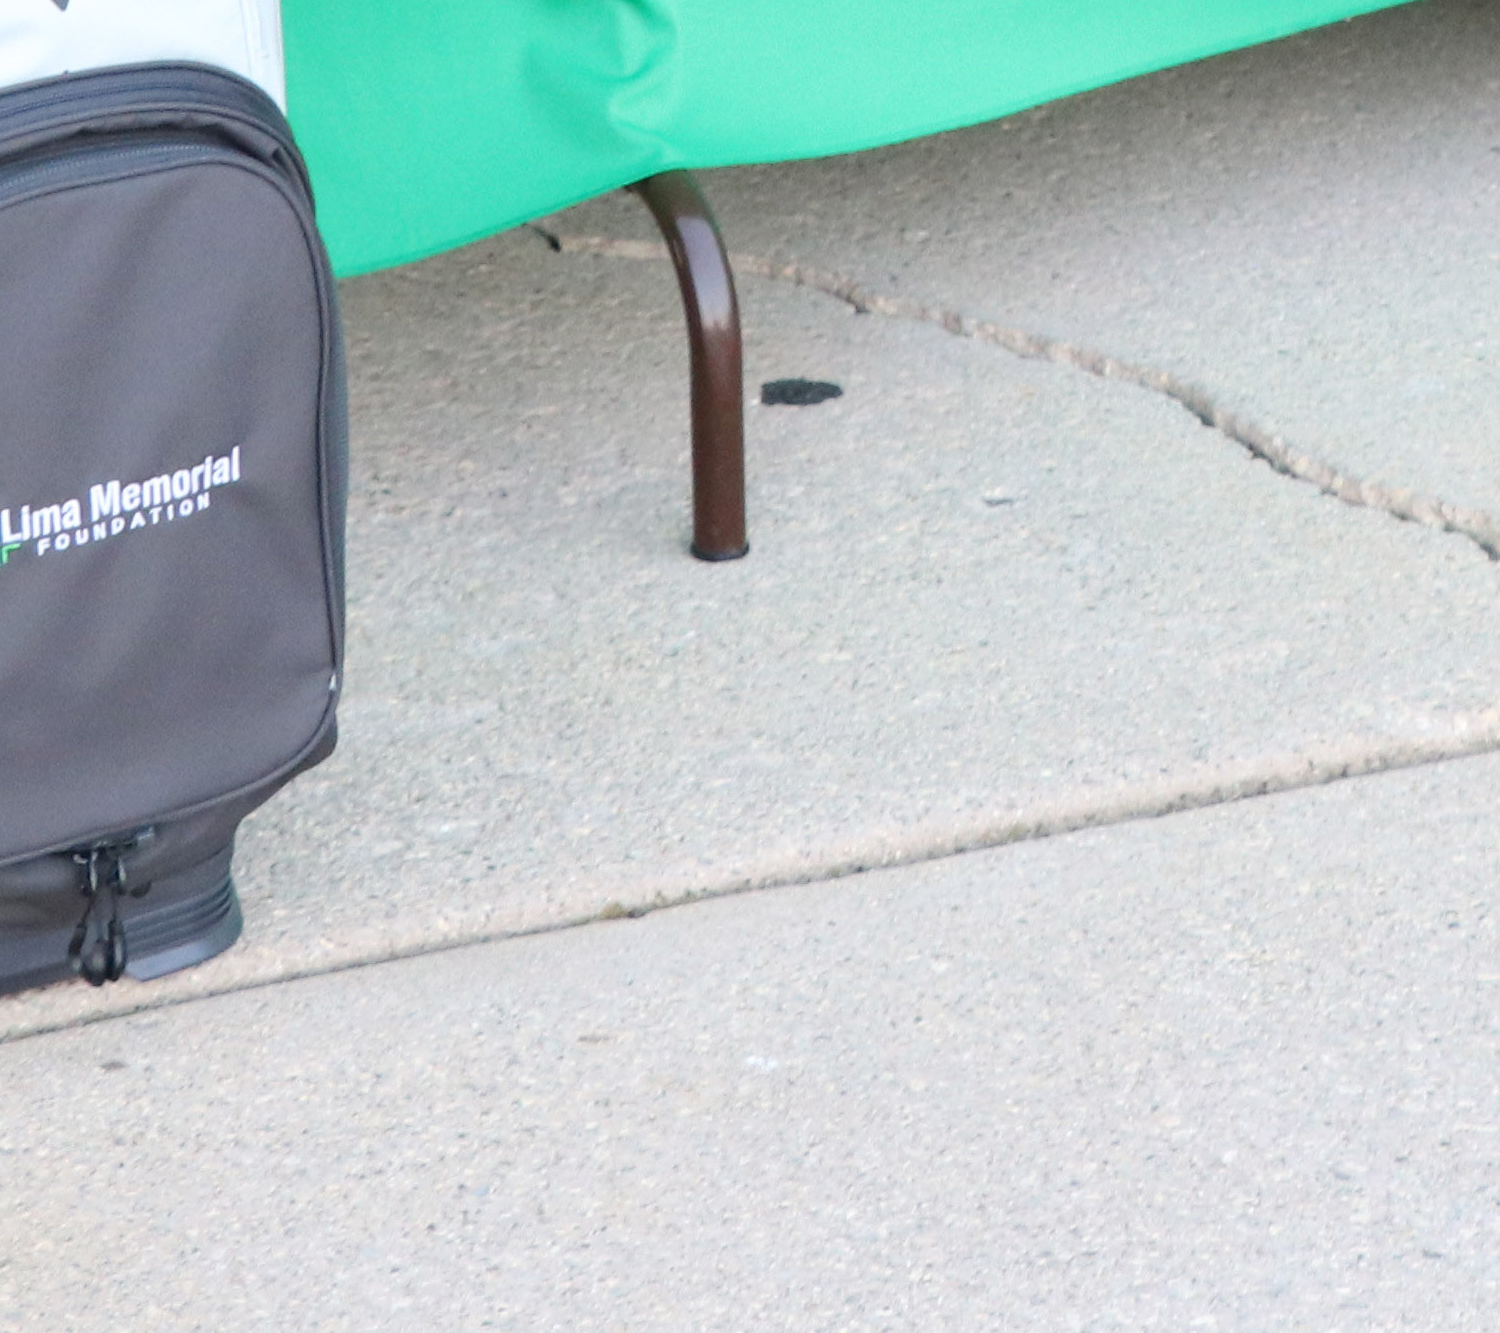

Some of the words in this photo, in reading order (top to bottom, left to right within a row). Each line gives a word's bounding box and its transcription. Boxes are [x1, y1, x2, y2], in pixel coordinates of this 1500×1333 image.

[0, 505, 82, 544] Lima
[88, 444, 241, 523] Memorial
[36, 491, 211, 557] FOUNDATION
